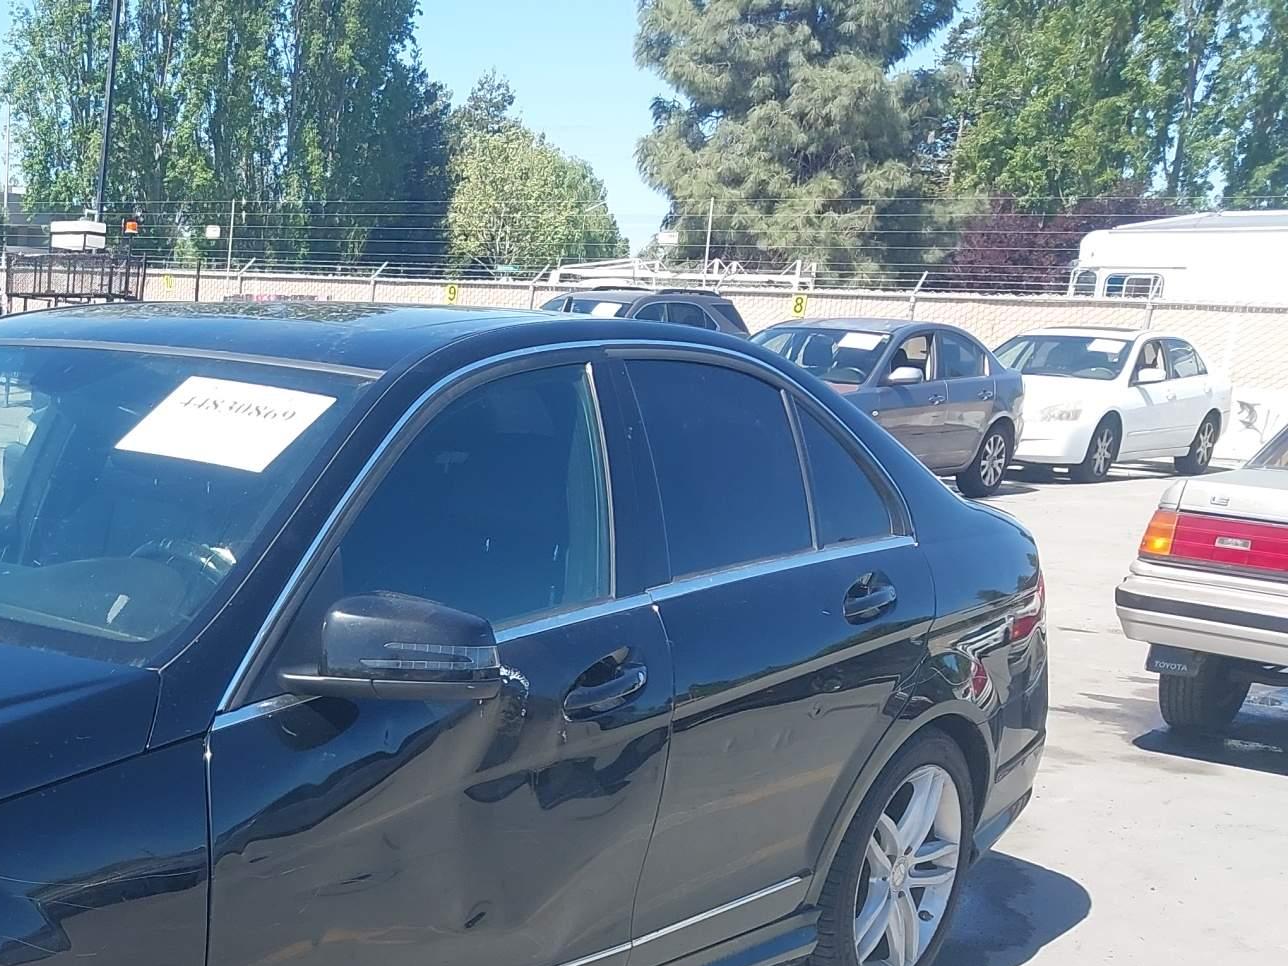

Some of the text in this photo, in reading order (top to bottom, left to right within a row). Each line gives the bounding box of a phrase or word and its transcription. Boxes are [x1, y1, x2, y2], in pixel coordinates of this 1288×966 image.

[448, 285, 457, 302] 9
[793, 296, 804, 314] 8
[1154, 660, 1189, 672] TOYOTA
